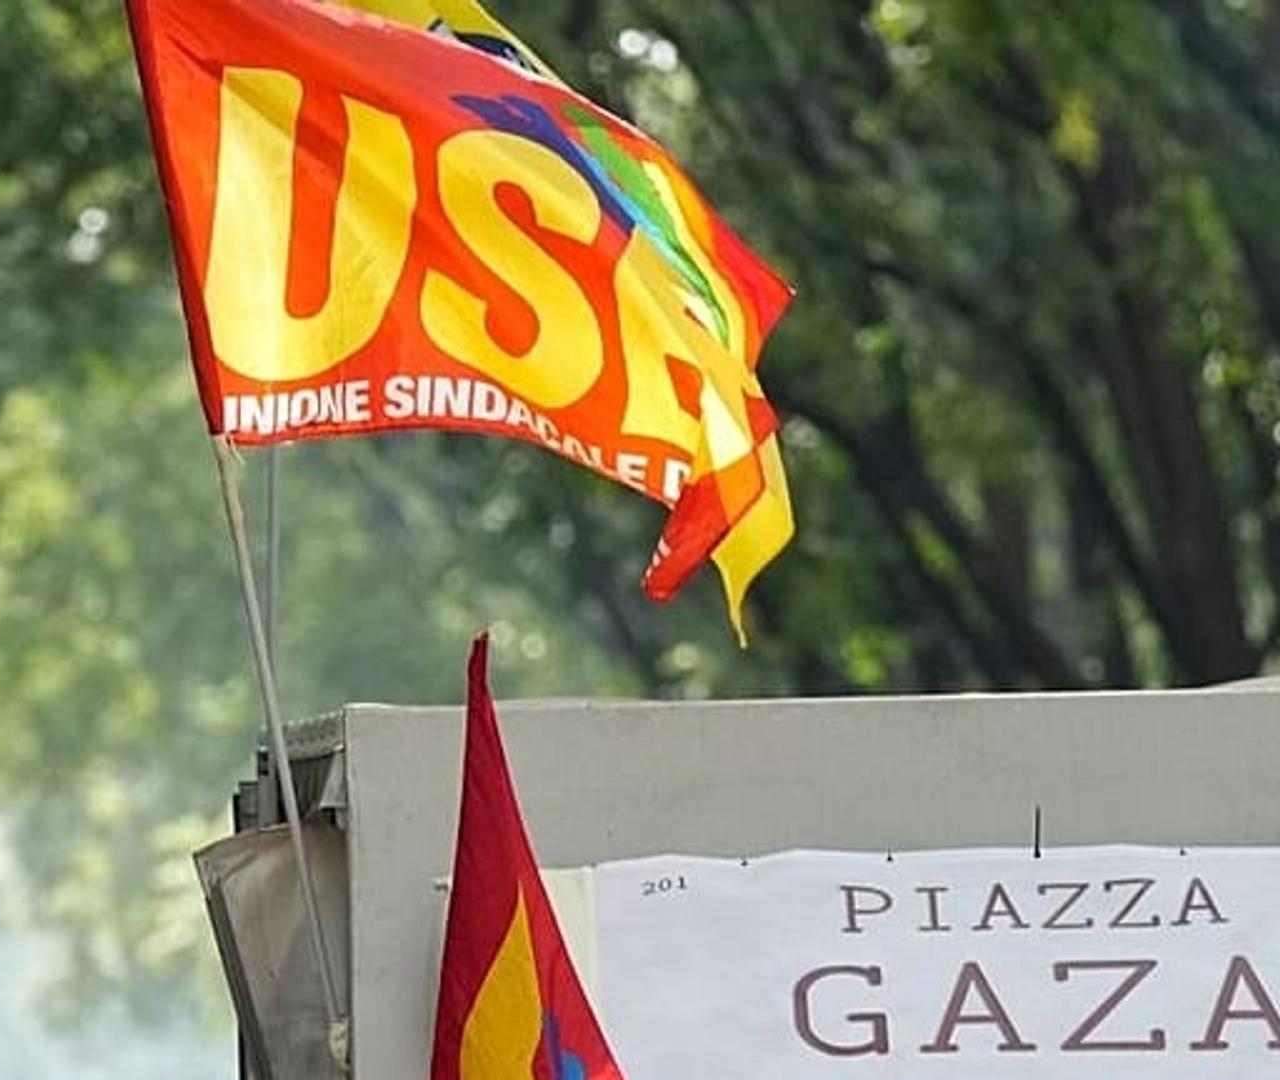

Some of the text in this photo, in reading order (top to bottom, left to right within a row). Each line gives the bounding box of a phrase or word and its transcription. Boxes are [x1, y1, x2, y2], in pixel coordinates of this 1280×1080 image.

[384, 374, 647, 491] SINDACALE
[640, 875, 687, 897] 201
[839, 877, 1229, 934] PIAZZA
